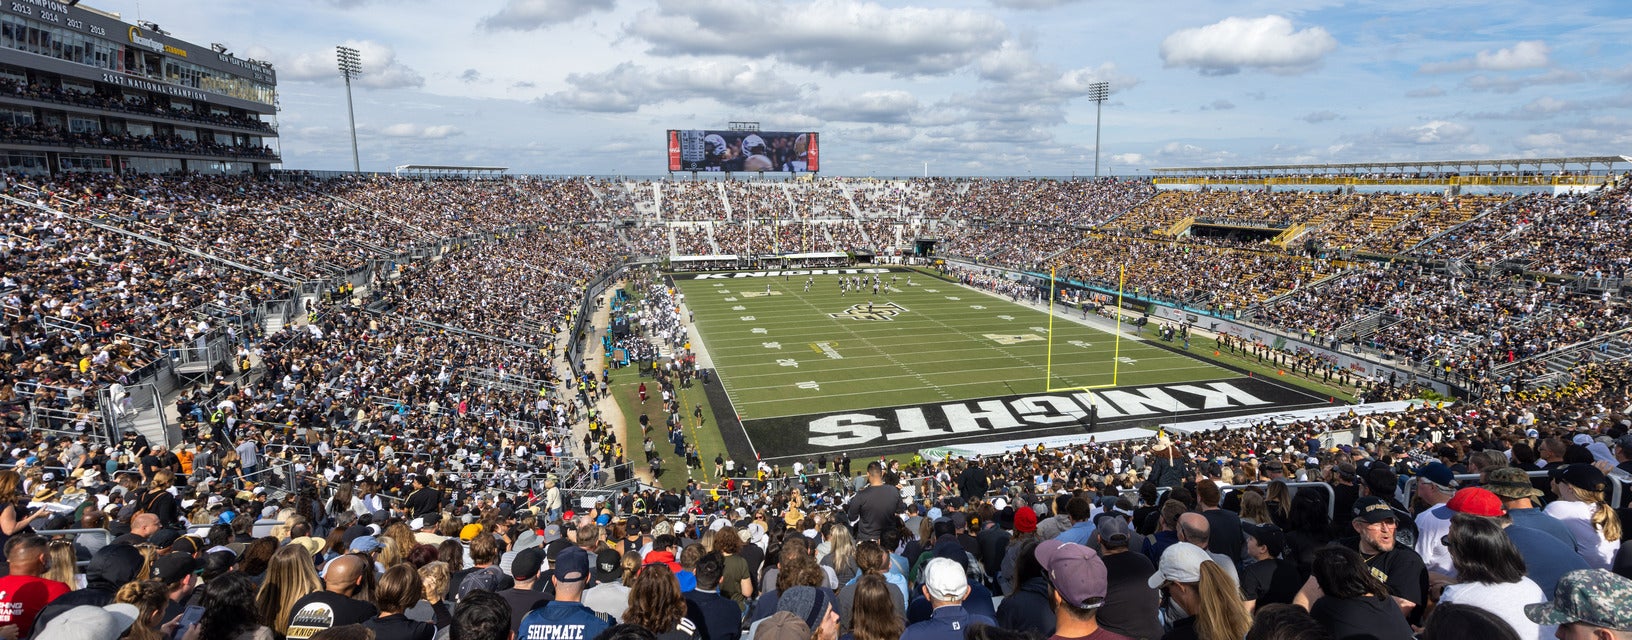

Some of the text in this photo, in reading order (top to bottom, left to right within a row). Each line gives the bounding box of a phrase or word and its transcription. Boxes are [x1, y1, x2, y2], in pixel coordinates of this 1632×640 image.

[12, 2, 32, 15] 2013
[40, 10, 59, 22] 2014
[66, 18, 83, 29] 2017
[23, 0, 68, 14] AMPIONS
[103, 73, 207, 101] 2017 NATIONAL CHAMPIONS
[808, 382, 1275, 447] KNIGHTS
[1431, 430, 1442, 443] 10
[294, 627, 320, 637] KNIG
[527, 624, 585, 640] SHIPMATE
[676, 617, 697, 636] 10
